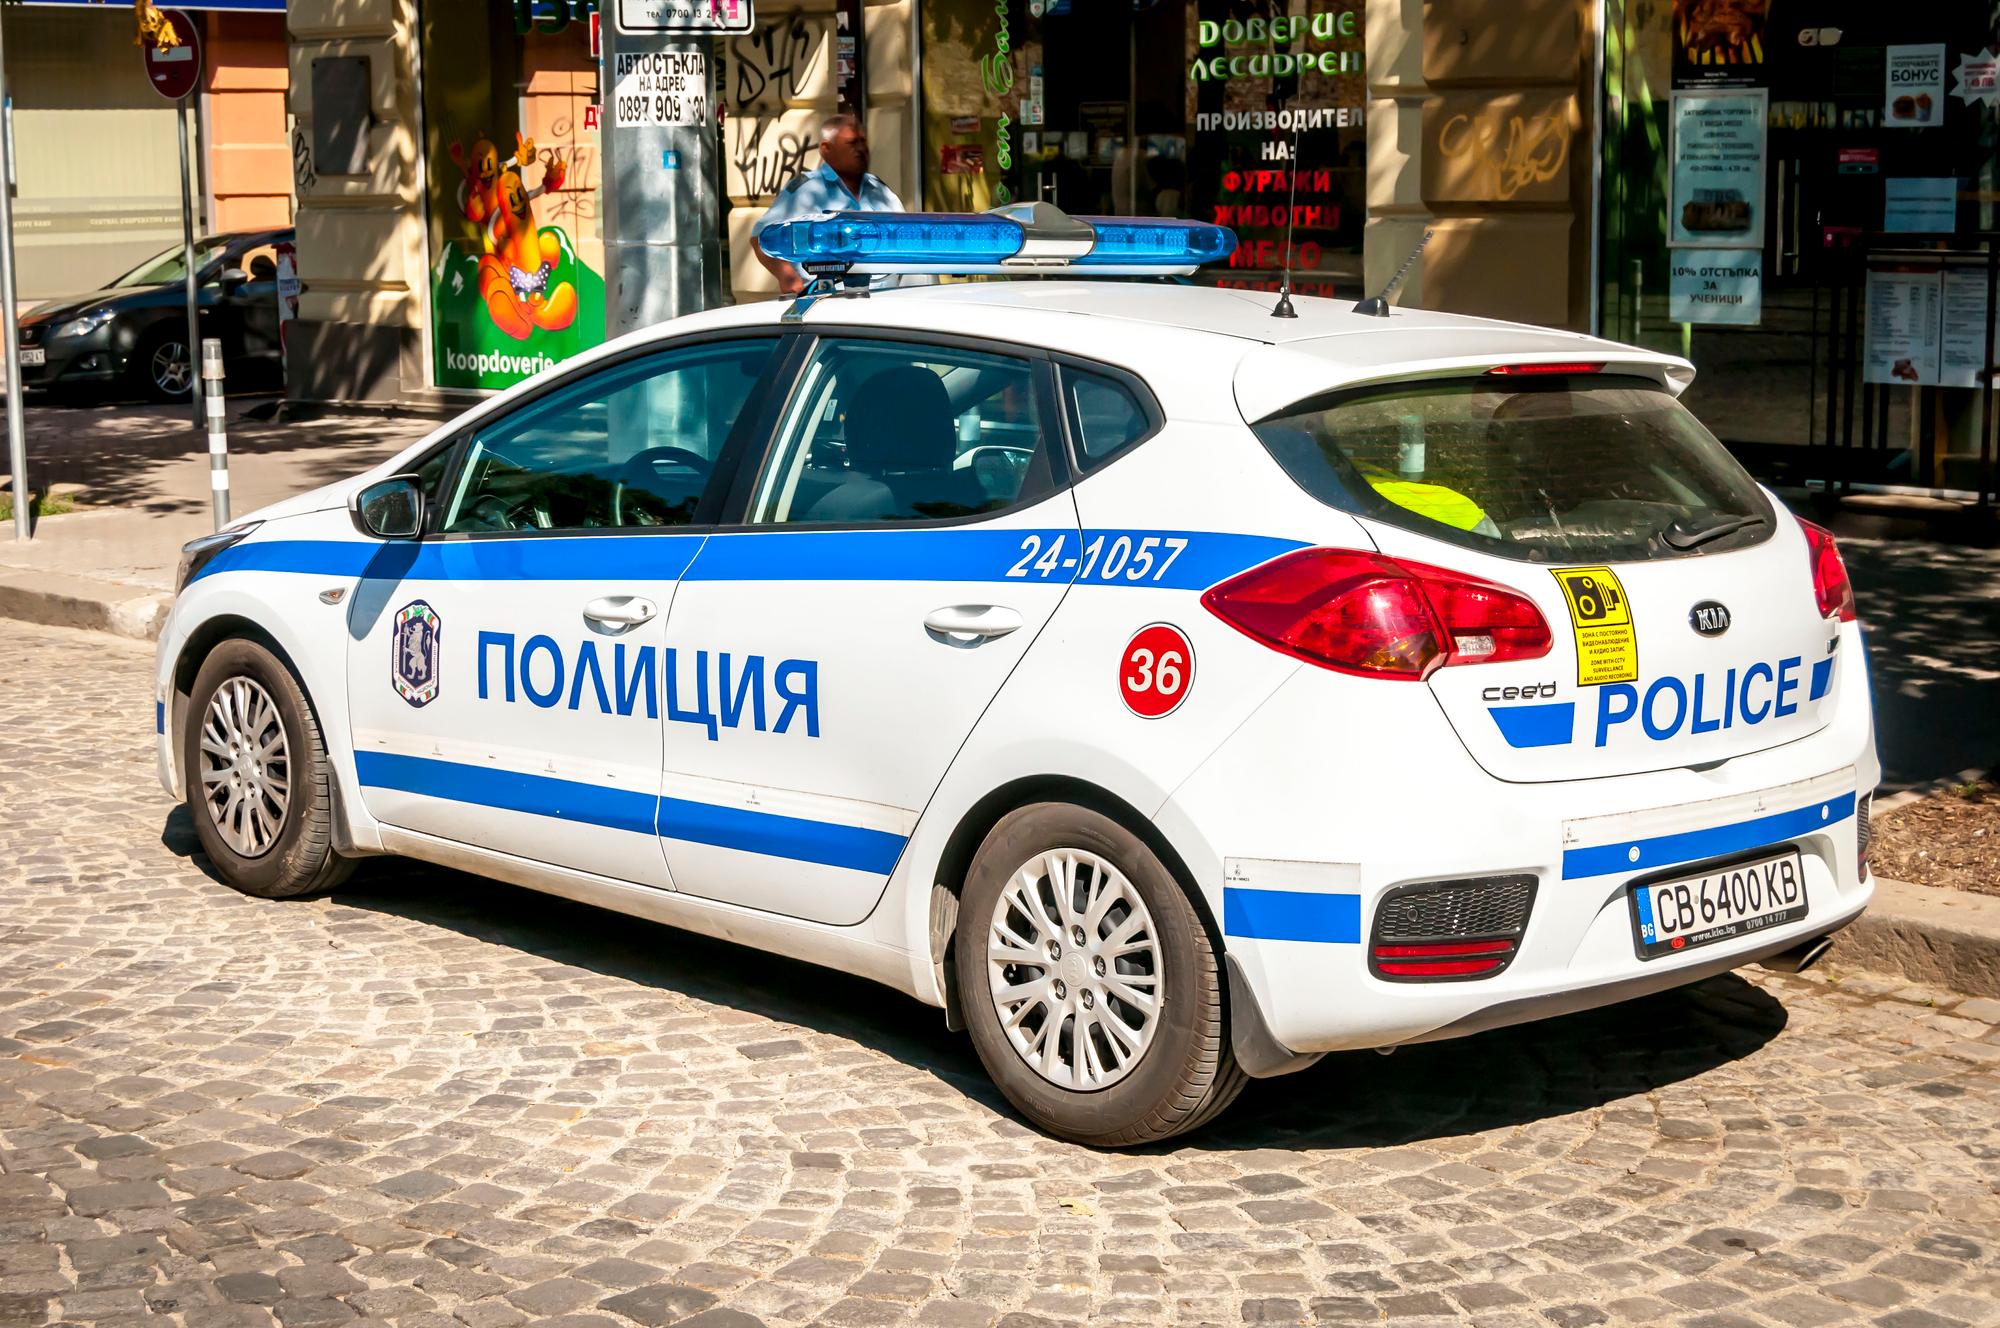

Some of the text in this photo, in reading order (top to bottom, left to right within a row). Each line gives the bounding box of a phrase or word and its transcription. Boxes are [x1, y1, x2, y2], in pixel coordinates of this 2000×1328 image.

[666, 9, 689, 18] 0700
[693, 9, 702, 18] 13
[1198, 11, 1356, 47] ДОВЕРИЕ
[617, 53, 705, 76] АВТОСТЪКЛА
[1190, 51, 1360, 82] ЛЕСИДРЕН
[1891, 69, 1939, 82] БОНУС
[639, 76, 686, 92] НА АДРЕС
[619, 96, 650, 122] 0897
[655, 95, 681, 122] 909
[1196, 107, 1364, 133] ПРОИЗВОДИТЕЛ
[1261, 141, 1296, 160] НА:
[1223, 170, 1331, 193] ФУРАЖИ
[1214, 205, 1340, 227] ЖИВОТНИ
[1229, 239, 1323, 270] МЕСО
[1672, 267, 1759, 277] 10% ОТСТЪПКА
[1703, 280, 1717, 290] ЗА
[1689, 294, 1743, 304] УЧЕНИЦИ
[1005, 534, 1188, 581] 24-1057
[1696, 607, 1728, 631] KIA
[1127, 648, 1183, 695] 36
[1593, 665, 1623, 673] SURVEILLANCE
[478, 630, 820, 742] ПОЛИЦИЯ
[1595, 656, 1802, 748] POLICE
[1640, 922, 1655, 938] BG
[1690, 925, 1737, 943] www.kia.bg
